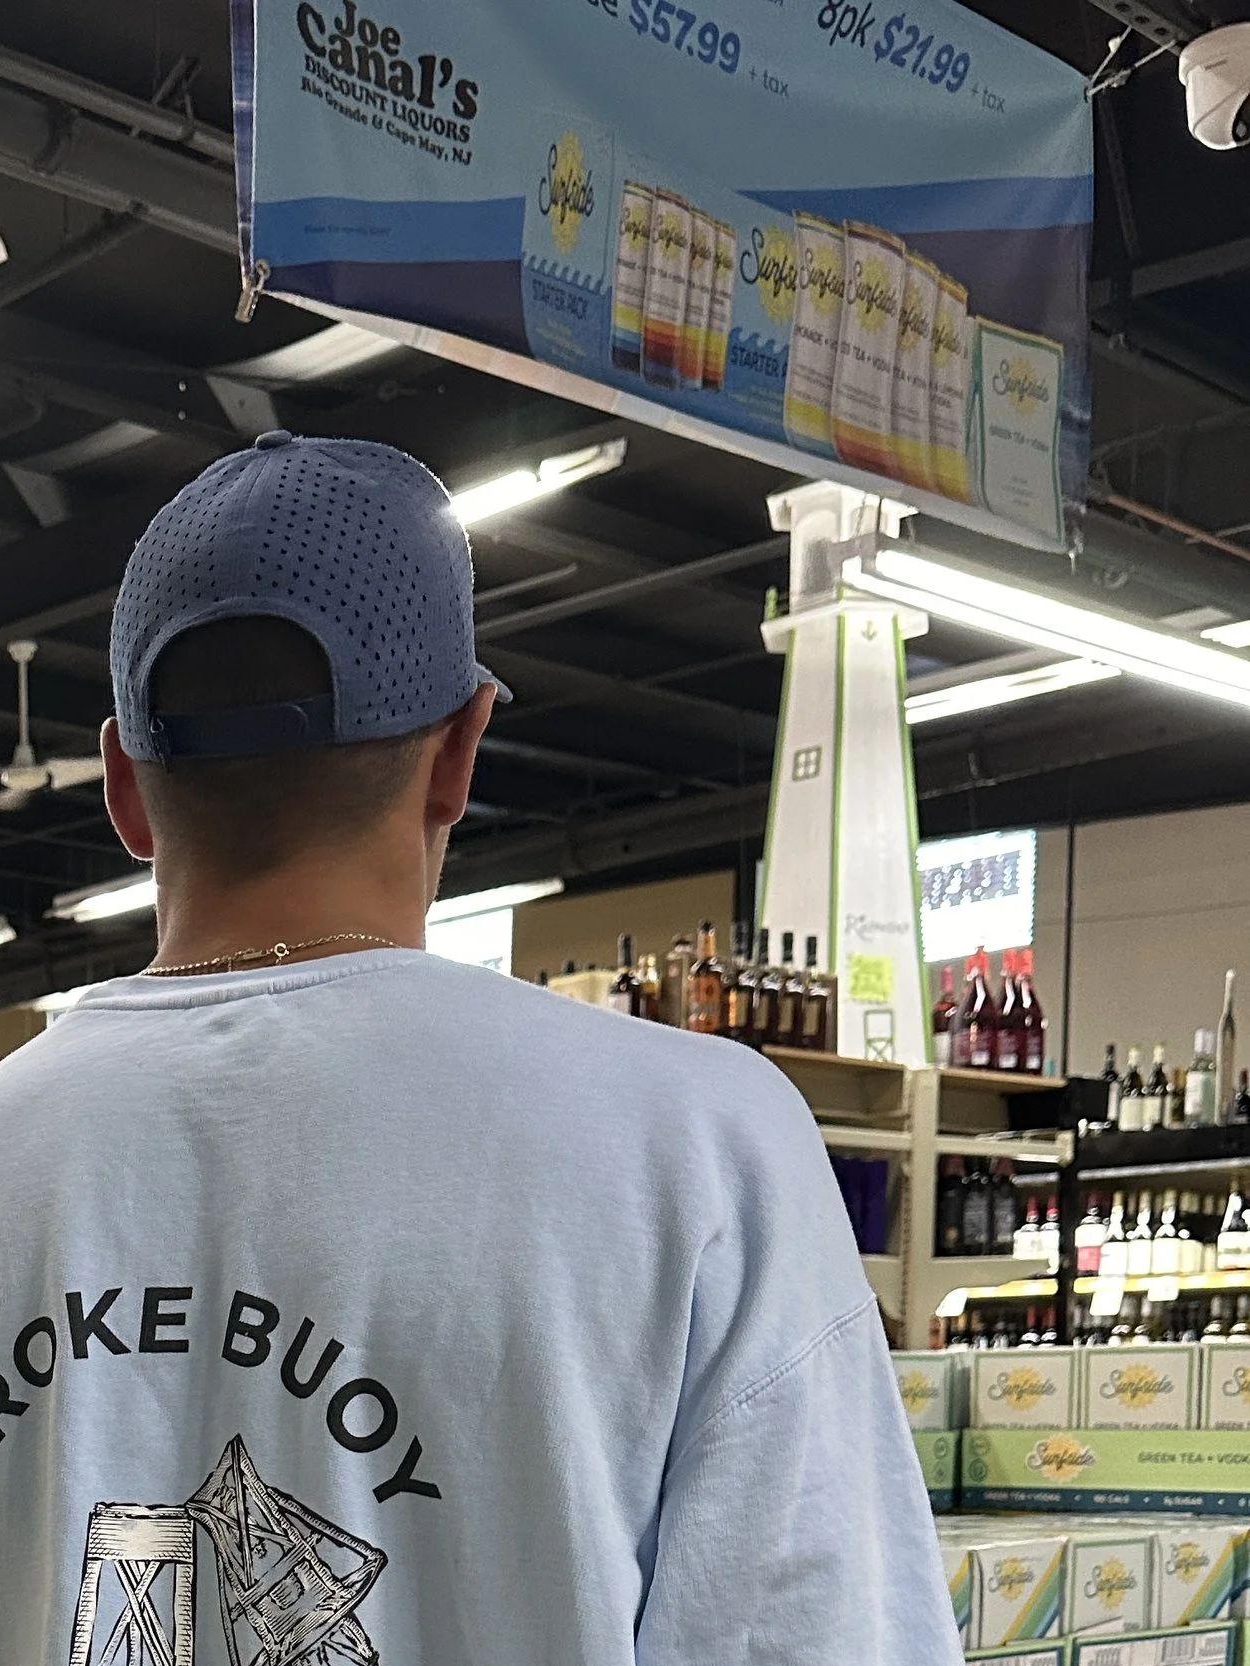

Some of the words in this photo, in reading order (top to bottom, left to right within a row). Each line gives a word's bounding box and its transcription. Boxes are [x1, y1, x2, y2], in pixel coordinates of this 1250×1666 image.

[297, 2, 479, 120] Canal's
[334, 0, 400, 56] Joe
[629, 0, 741, 75] $57.99
[763, 70, 789, 97] tax
[818, 0, 875, 47] 8pk
[874, 13, 970, 93] $21.99
[982, 87, 1006, 113] tax
[305, 53, 388, 112] DISCOUNT
[392, 100, 470, 143] LIQUORS
[452, 147, 472, 165] NJ
[219, 1288, 442, 1505] BUOY
[1180, 1452, 1203, 1464] TEA
[1217, 1453, 1250, 1465] VODK
